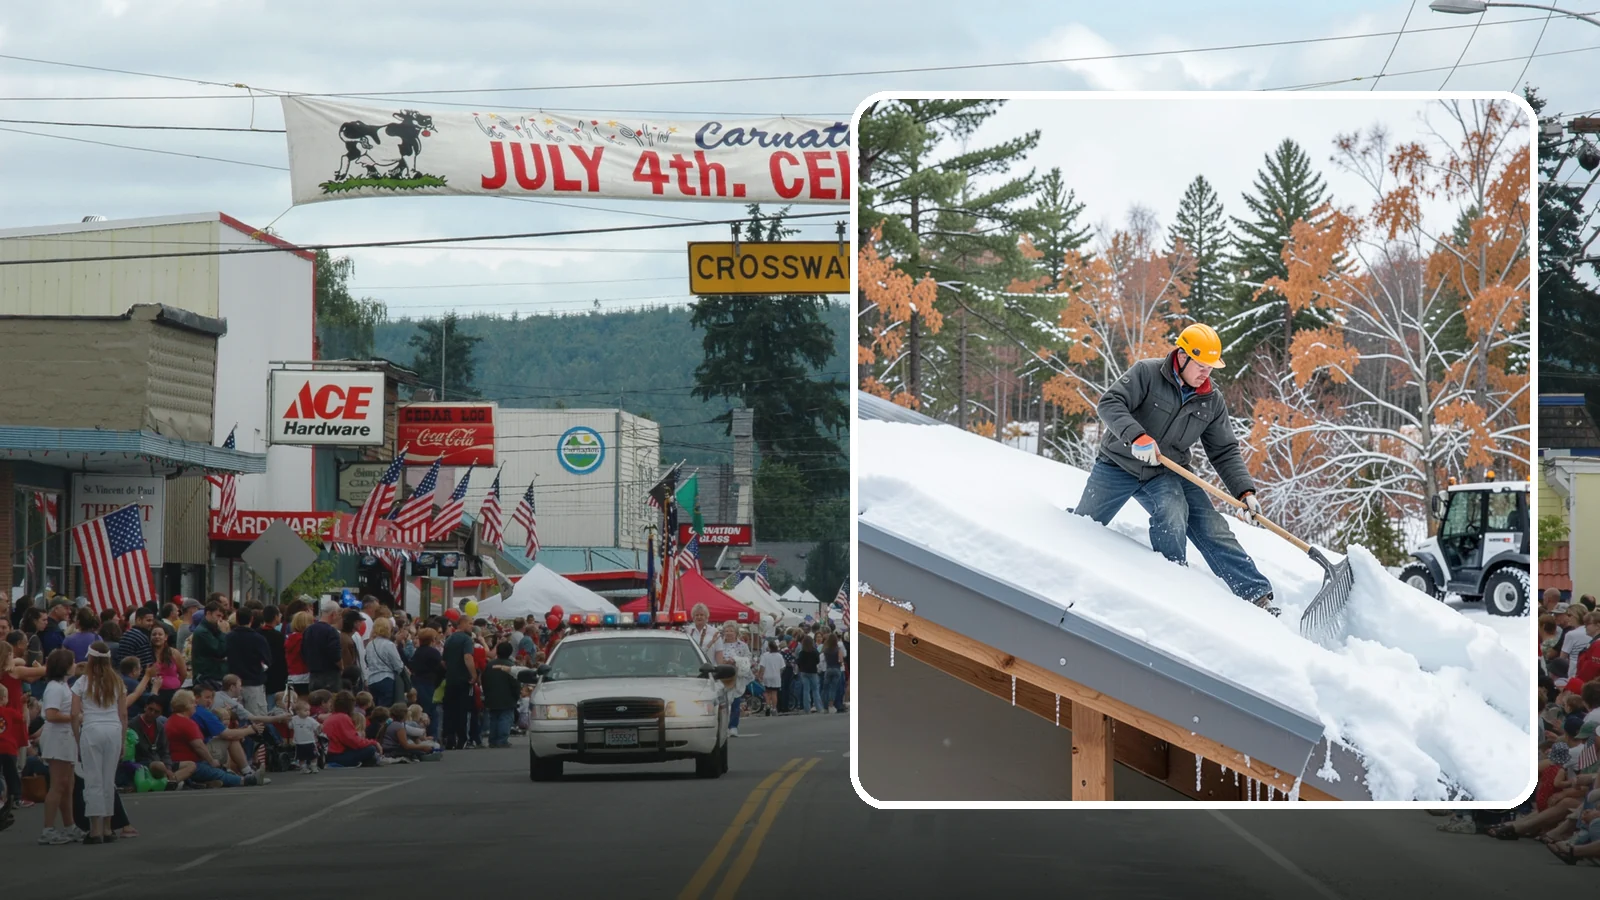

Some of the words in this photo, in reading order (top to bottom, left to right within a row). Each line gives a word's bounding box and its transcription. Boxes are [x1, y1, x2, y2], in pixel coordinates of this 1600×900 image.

[481, 140, 605, 193] JULY
[631, 150, 746, 198] 4th.
[696, 253, 850, 281] CROSSWA
[282, 379, 374, 420] ACE
[405, 408, 453, 422] CEDAR
[461, 408, 486, 422] LOG
[283, 420, 371, 437] Hardware
[416, 428, 477, 447] Coca-Cola
[353, 466, 387, 481] Simpl
[82, 484, 93, 495] St.
[95, 485, 124, 495] Vincent
[126, 485, 136, 495] de
[137, 485, 155, 495] Paul
[80, 502, 155, 522] THRT
[212, 516, 330, 536] HARDARE
[688, 526, 742, 535] CRNATION
[699, 535, 731, 544] GLASS
